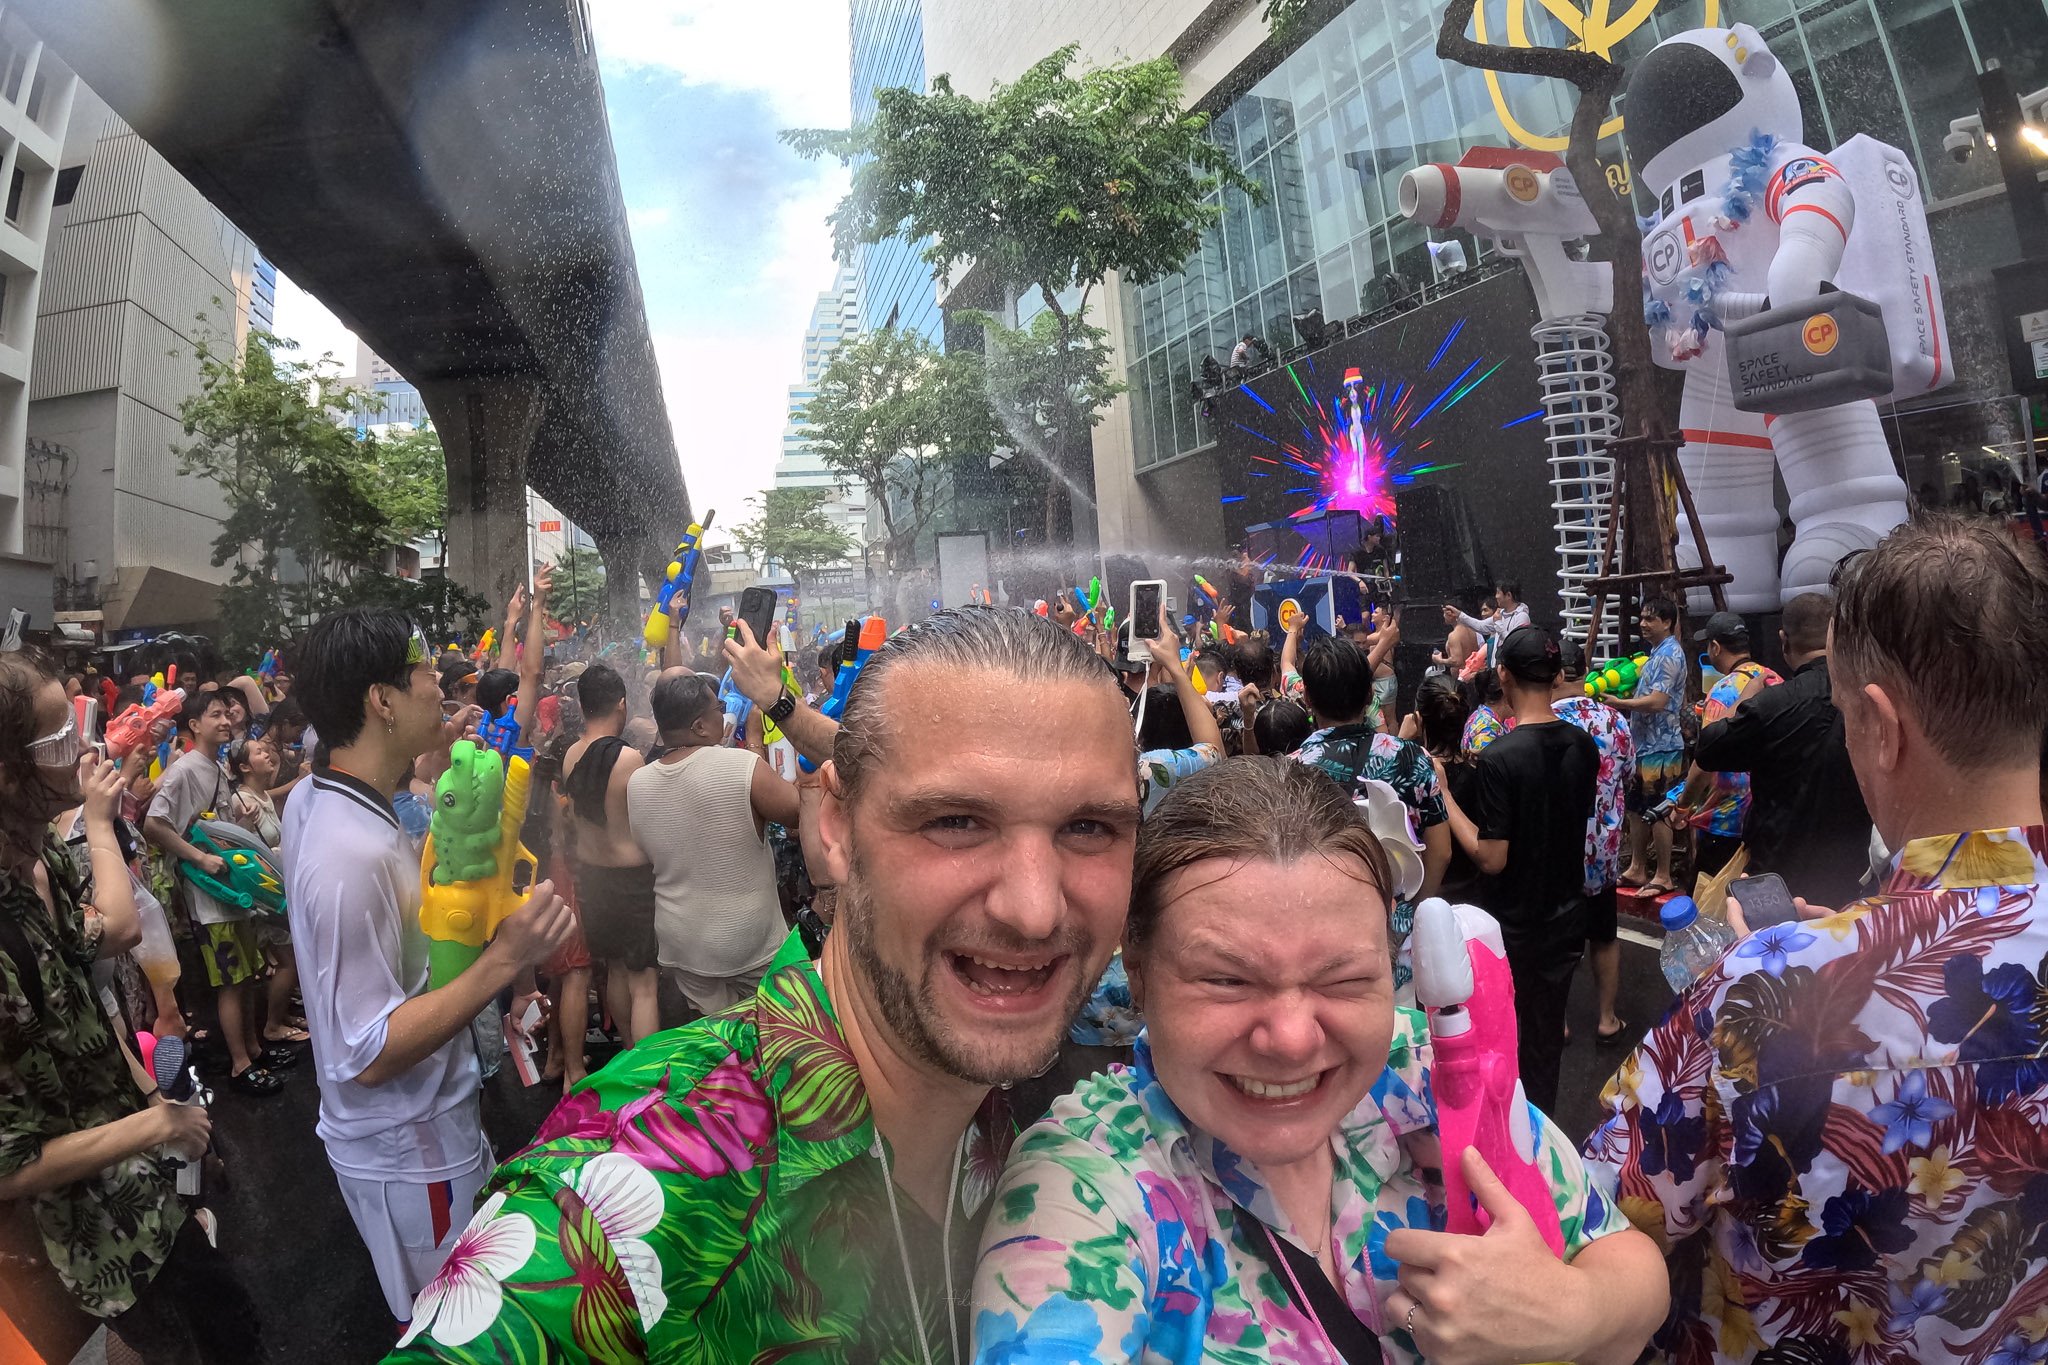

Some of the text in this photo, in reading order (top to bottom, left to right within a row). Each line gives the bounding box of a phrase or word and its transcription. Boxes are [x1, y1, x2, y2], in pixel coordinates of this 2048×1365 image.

[1511, 176, 1533, 192] CP
[1653, 243, 1675, 272] CP
[1897, 200, 1926, 354] PACE SAFETY STANDARD
[1808, 324, 1833, 344] CP
[1739, 352, 1778, 372] SPACE
[1741, 363, 1789, 385] SAFETY
[1743, 373, 1814, 397] STANDARD
